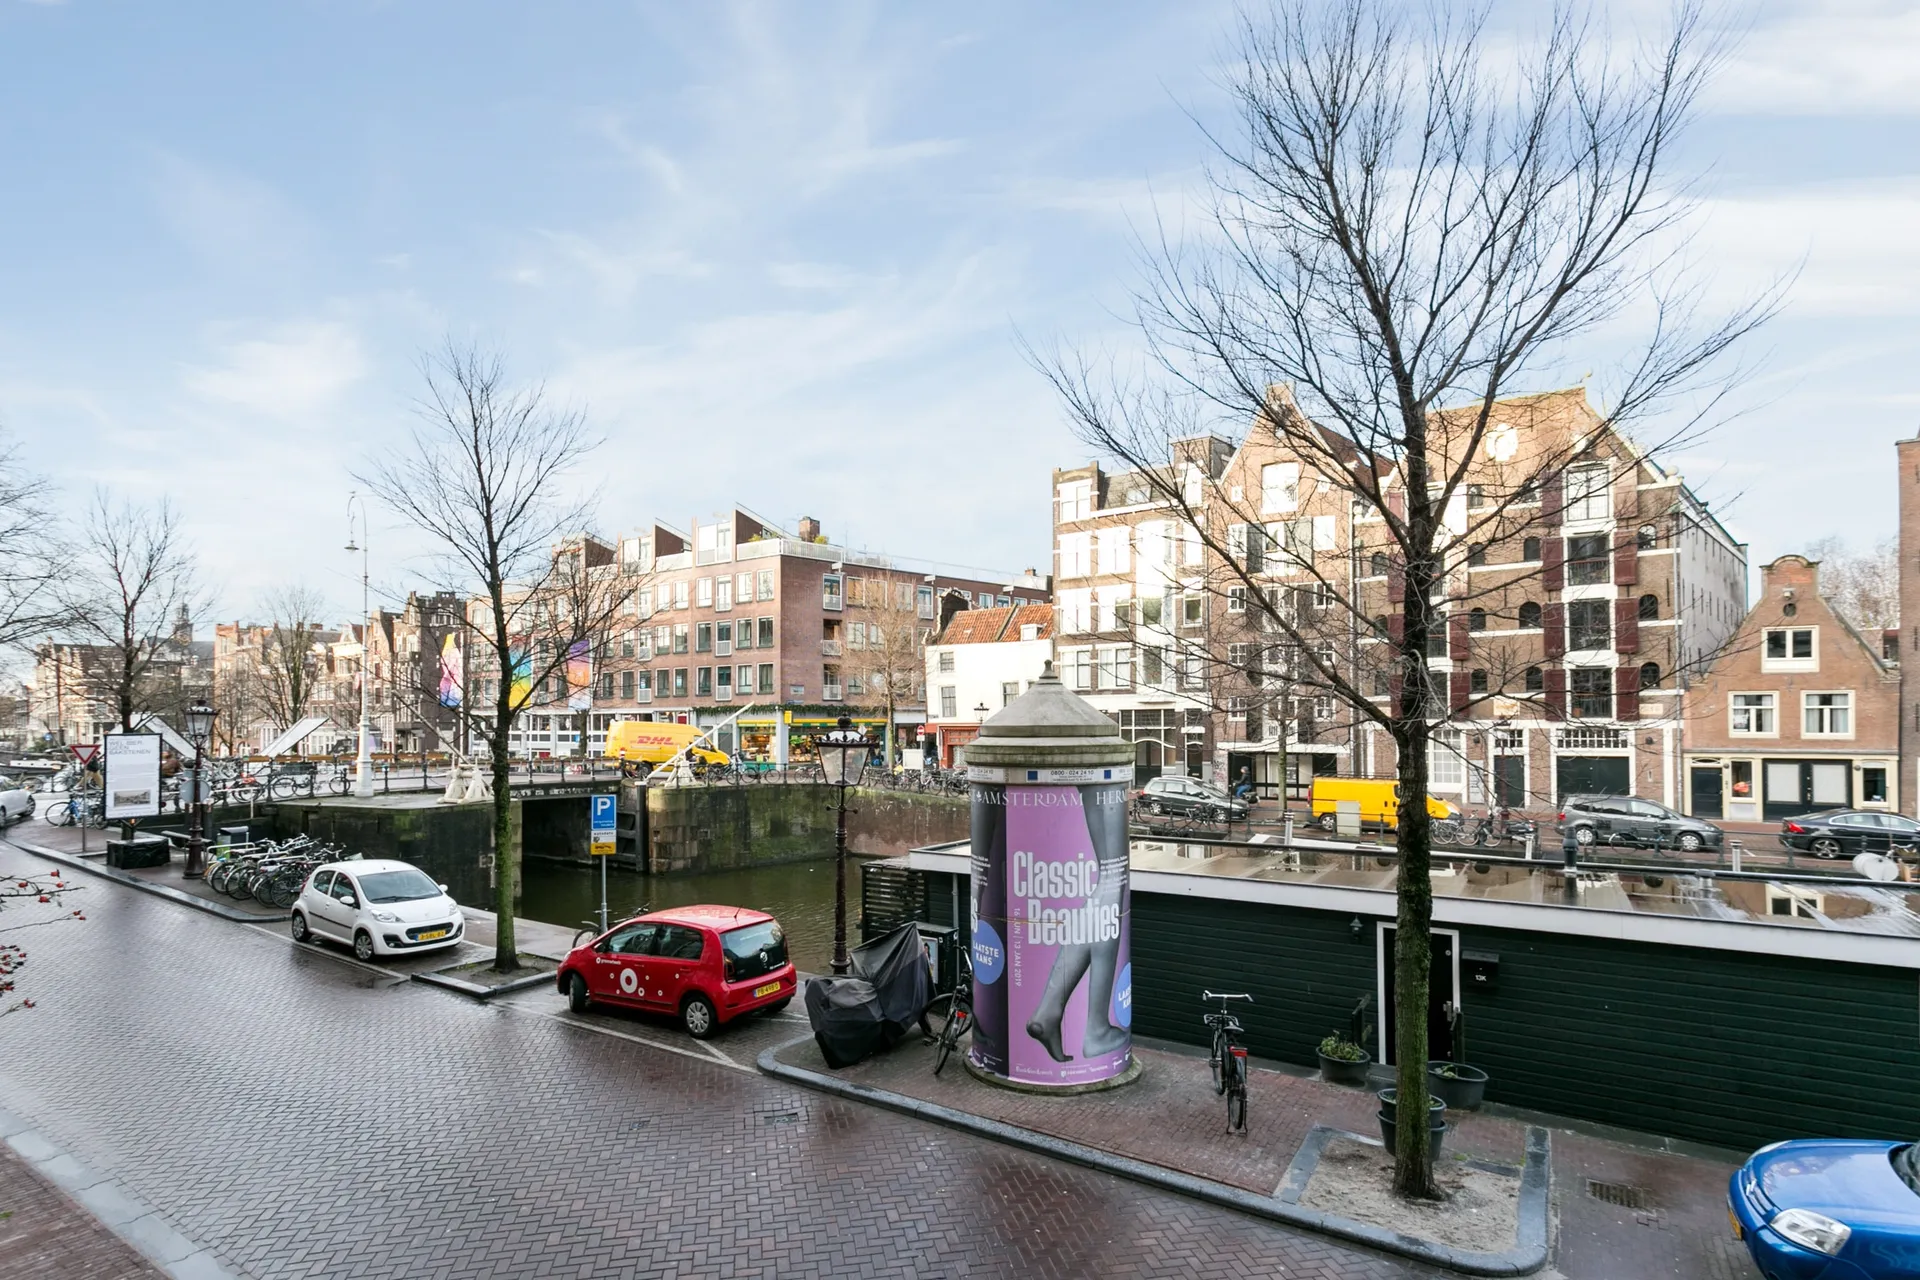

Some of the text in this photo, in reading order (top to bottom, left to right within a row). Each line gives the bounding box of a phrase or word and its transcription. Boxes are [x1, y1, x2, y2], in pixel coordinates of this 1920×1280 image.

[637, 735, 674, 745] DHL
[597, 797, 611, 816] P
[982, 790, 1084, 808] AMSTERDAM
[1013, 851, 1098, 898] Classic
[1028, 898, 1120, 946] Beauties
[973, 940, 999, 958] LAATSTE
[976, 952, 991, 966] KANS
[1014, 951, 1022, 967] JAN
[1014, 968, 1022, 987] 2019
